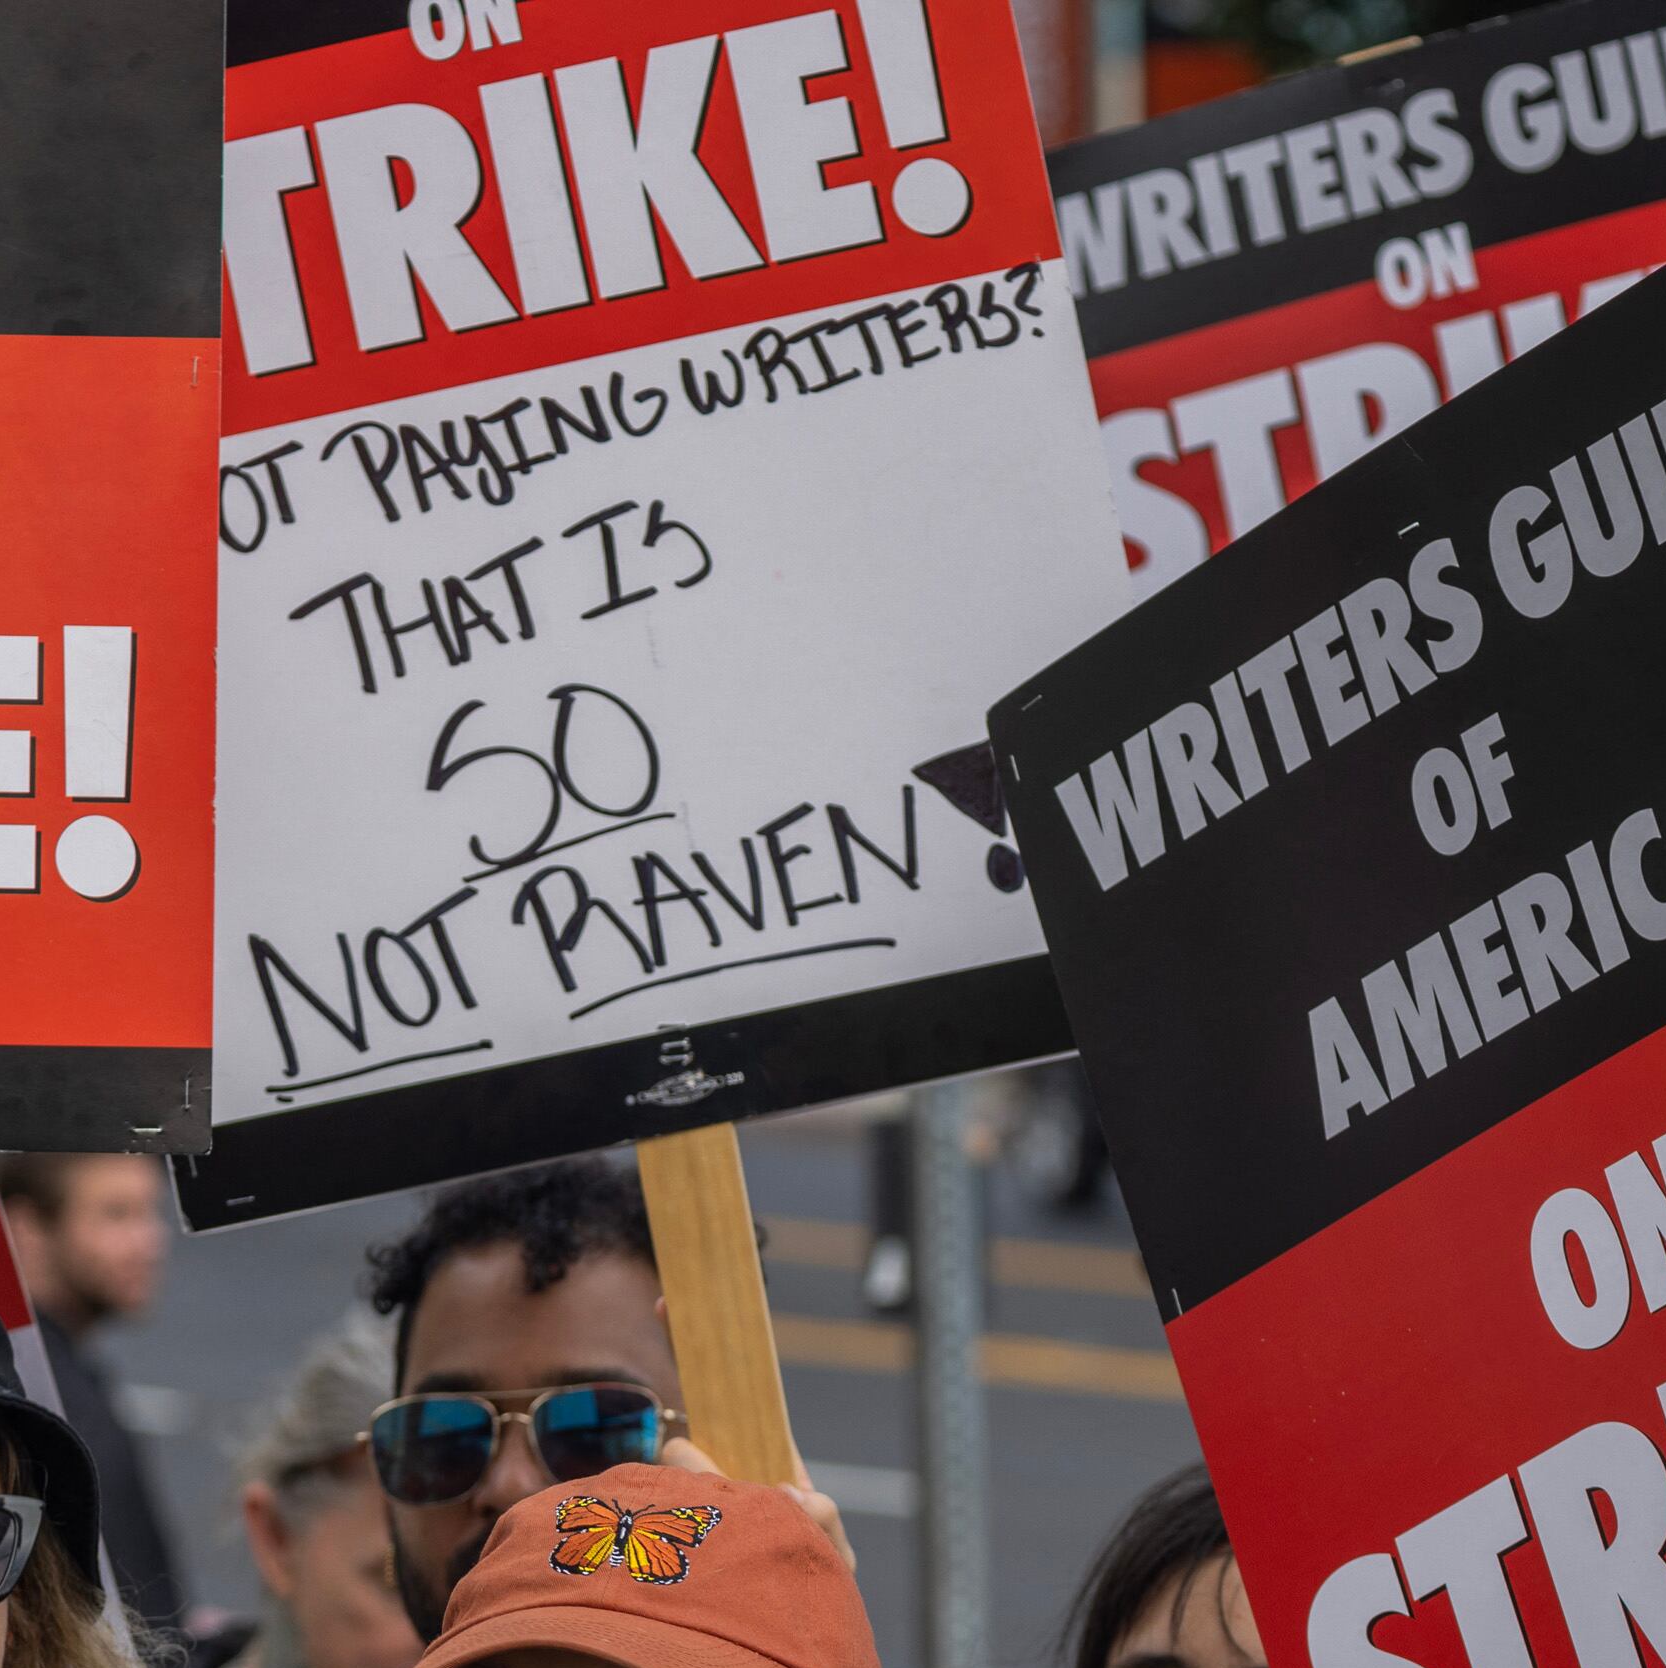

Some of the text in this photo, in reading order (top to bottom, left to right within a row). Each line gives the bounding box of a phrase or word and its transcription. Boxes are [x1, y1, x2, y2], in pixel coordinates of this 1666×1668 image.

[407, 0, 523, 61] ON
[222, 0, 973, 377] TRIKE!
[1057, 87, 1474, 300] WRITERS
[1373, 221, 1480, 310] ON
[219, 260, 1046, 553] OT PAYING WRITERS?
[289, 500, 711, 694] THAT IS
[426, 683, 659, 868] SO
[1054, 536, 1483, 893] WRITERS
[1411, 711, 1514, 857] OF
[248, 886, 479, 1077] NOT
